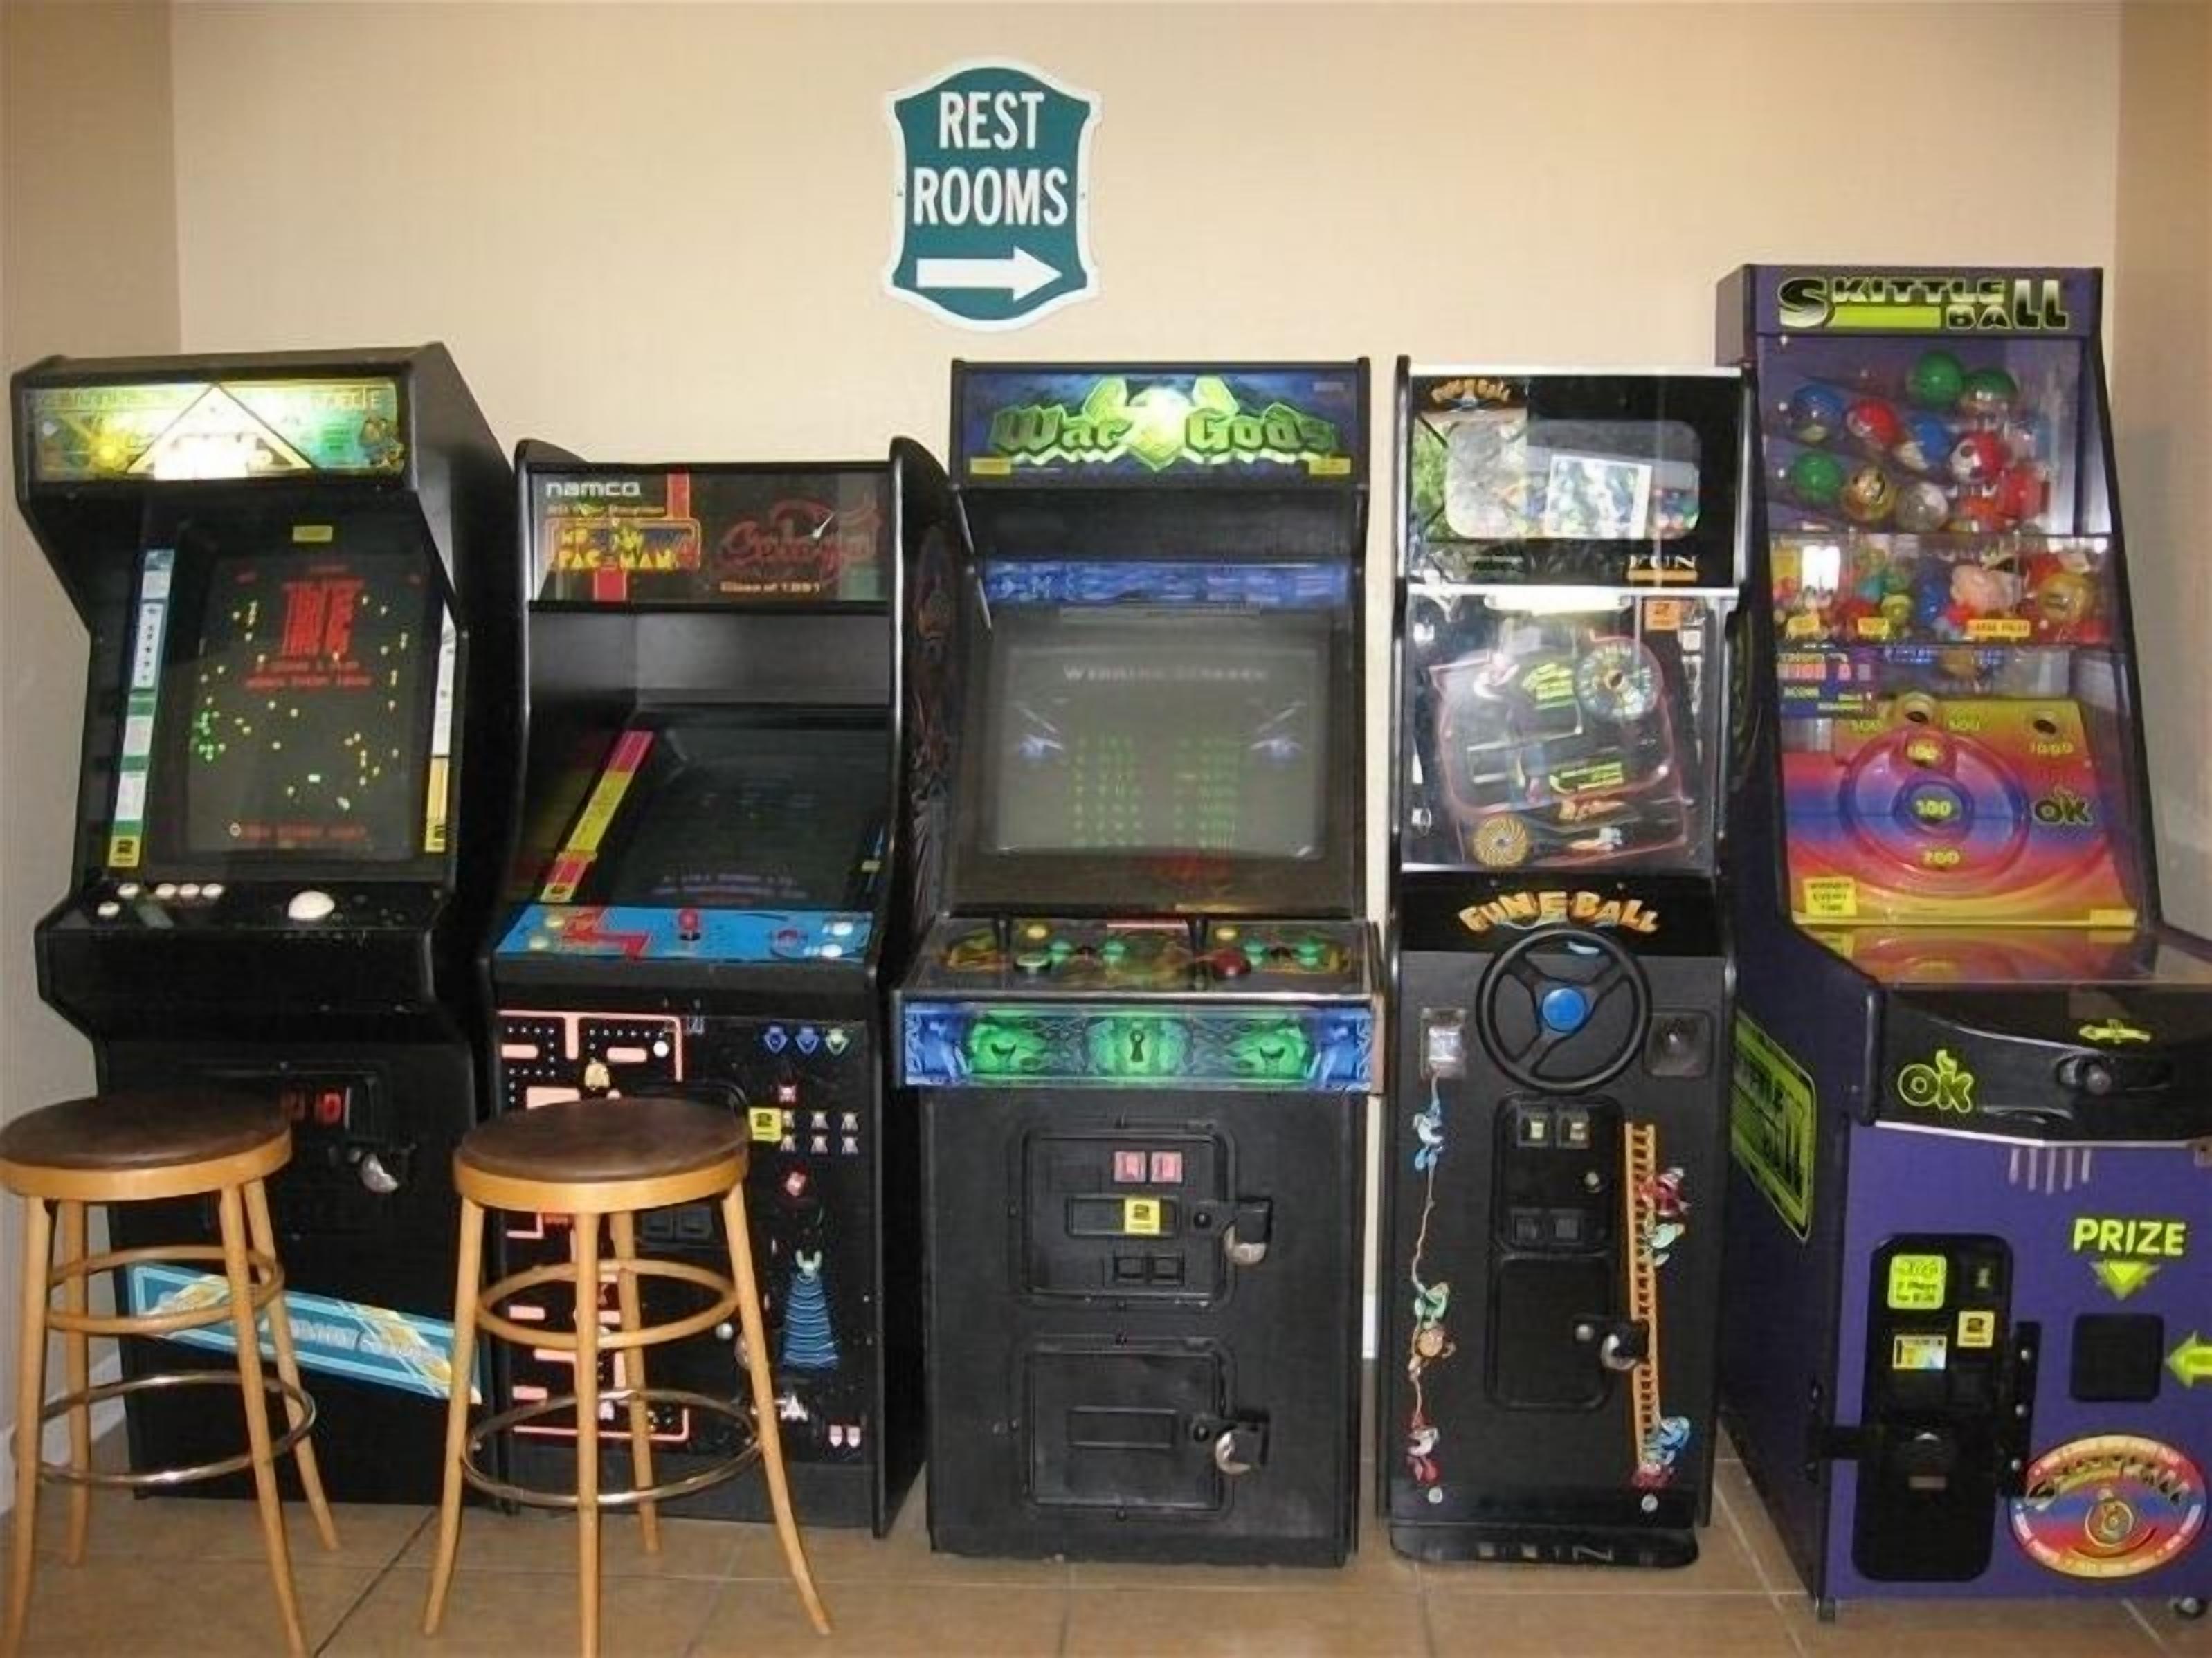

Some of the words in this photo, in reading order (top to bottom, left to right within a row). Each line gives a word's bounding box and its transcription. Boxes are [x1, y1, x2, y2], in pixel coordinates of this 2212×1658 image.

[939, 91, 1044, 149] REST
[913, 167, 1069, 226] ROOMS
[1778, 277, 2006, 329] SKITTLE
[1946, 278, 2069, 330] BALL
[990, 403, 1134, 454] War
[1184, 401, 1340, 454] Gods
[546, 482, 641, 496] namco
[2072, 1217, 2187, 1256] PRIZE
